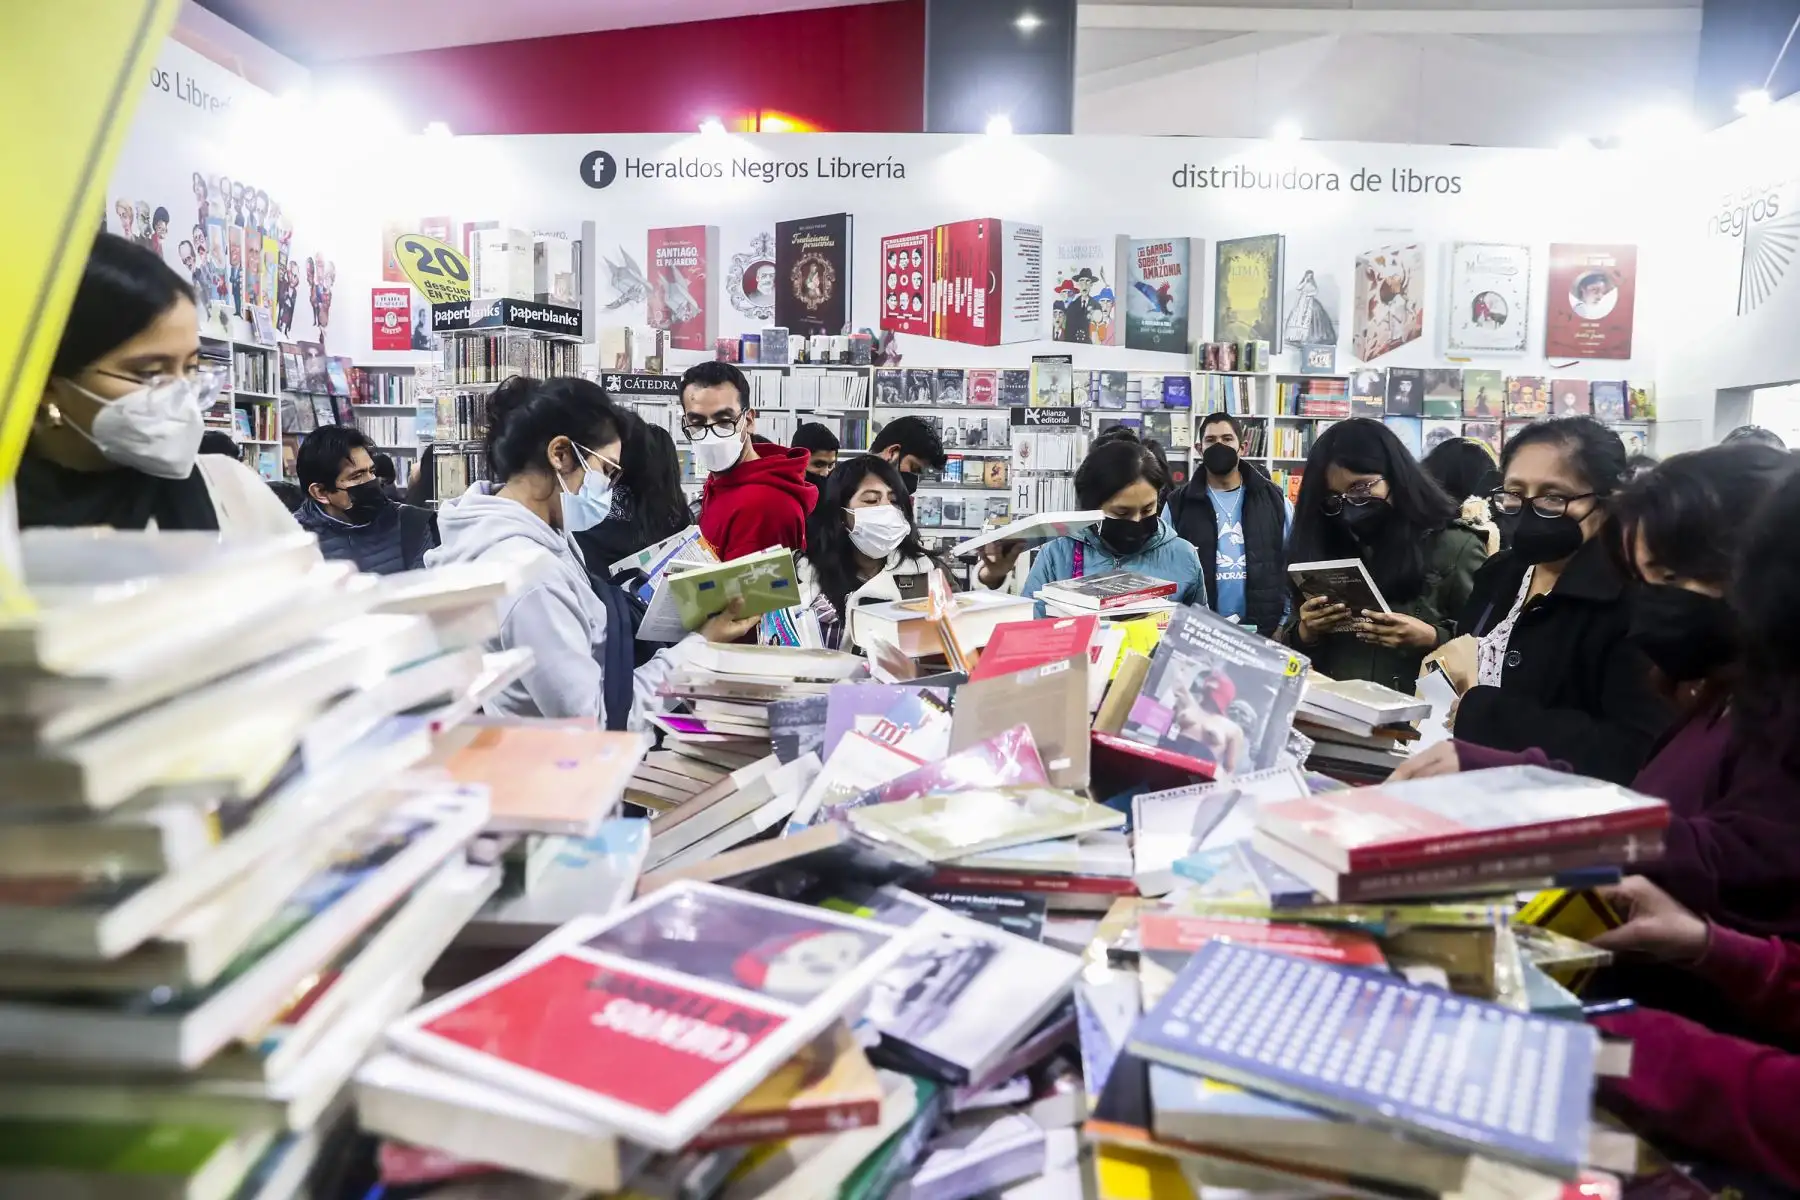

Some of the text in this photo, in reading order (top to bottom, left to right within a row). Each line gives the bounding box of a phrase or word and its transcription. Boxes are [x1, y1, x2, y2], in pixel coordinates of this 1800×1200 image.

[625, 156, 906, 183] Heraldos Negros Librería
[1172, 163, 1462, 194] distribuidora de libros
[1708, 194, 1779, 238] negros
[1146, 243, 1173, 256] GARRAS
[404, 240, 470, 282] 20
[1138, 255, 1159, 268] SOBRE
[428, 288, 444, 301] EN
[434, 304, 501, 326] paperblanks
[510, 305, 579, 327] paperblanks
[624, 377, 678, 390] CÁTEDRA
[1041, 409, 1066, 417] Alianza
[1041, 416, 1070, 424] editorial
[1183, 623, 1196, 634] La
[1186, 615, 1212, 633] Mayo
[1180, 632, 1191, 641] el
